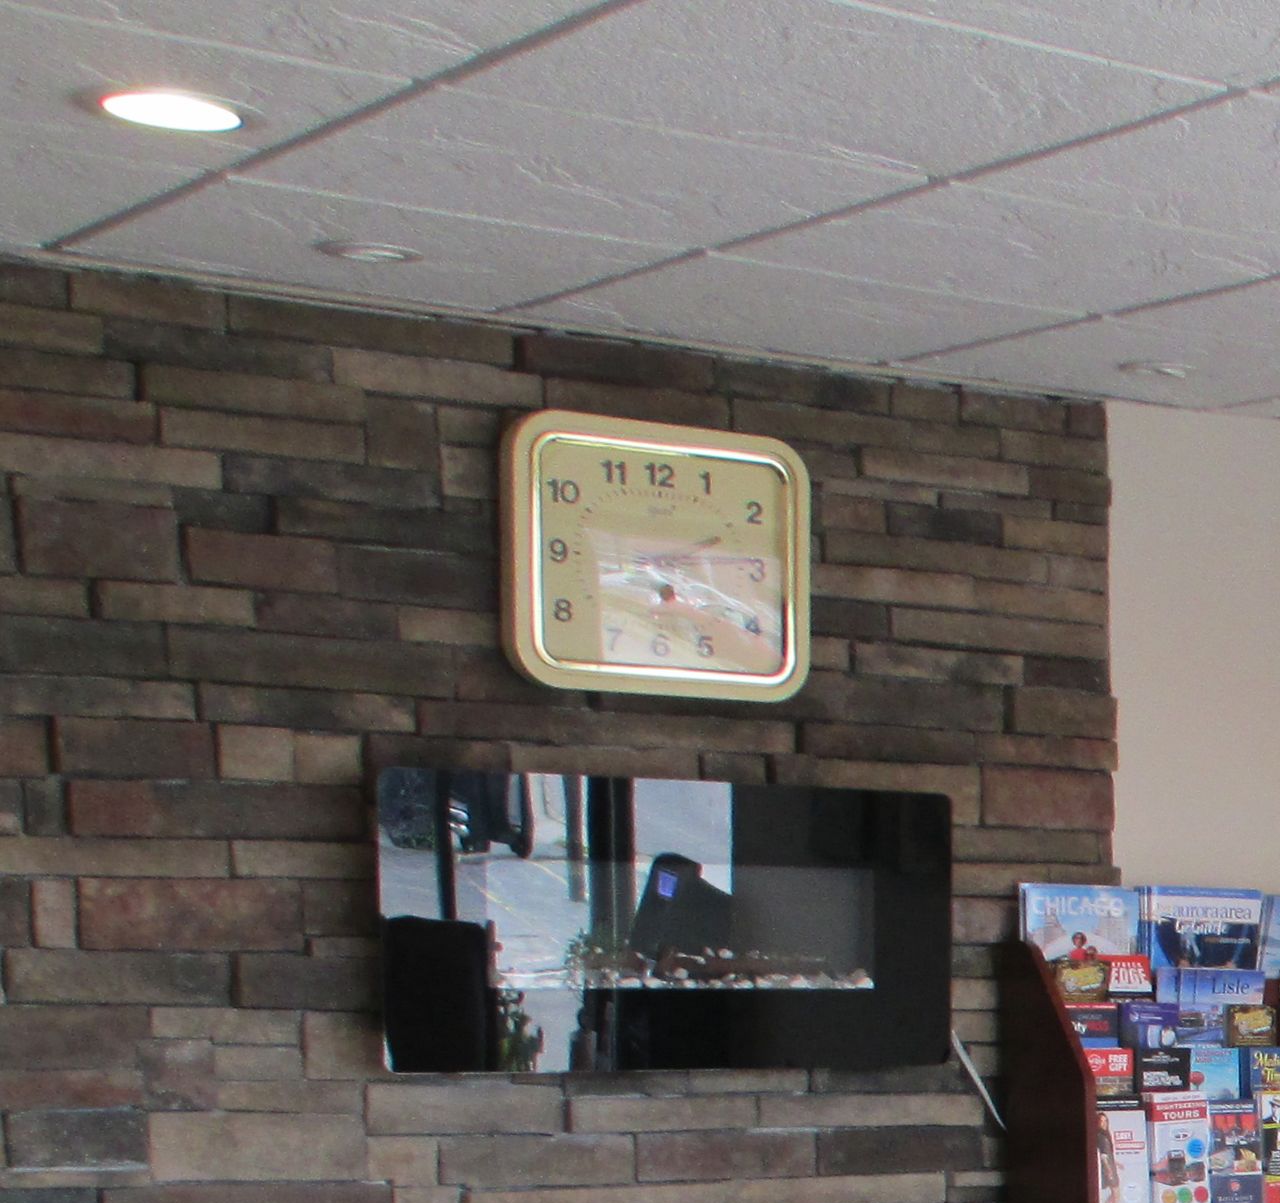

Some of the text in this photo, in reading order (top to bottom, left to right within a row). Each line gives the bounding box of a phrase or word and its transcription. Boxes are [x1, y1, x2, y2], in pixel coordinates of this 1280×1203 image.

[600, 459, 628, 485] 11
[644, 463, 675, 488] 12
[699, 471, 713, 495] 1
[547, 478, 580, 504] 10
[746, 501, 763, 524] 2
[548, 538, 568, 562] 9
[749, 559, 766, 582] 3
[552, 599, 573, 622] 8
[605, 626, 623, 651] 7
[651, 633, 669, 656] 6
[698, 635, 715, 657] 5
[1033, 896, 1125, 917] CHICAGO
[1110, 967, 1147, 985] EDGE
[1211, 974, 1251, 995] Lisle
[1108, 1053, 1128, 1063] FREE
[1108, 1063, 1128, 1072] GIFT
[1162, 1110, 1200, 1120] TOURS
